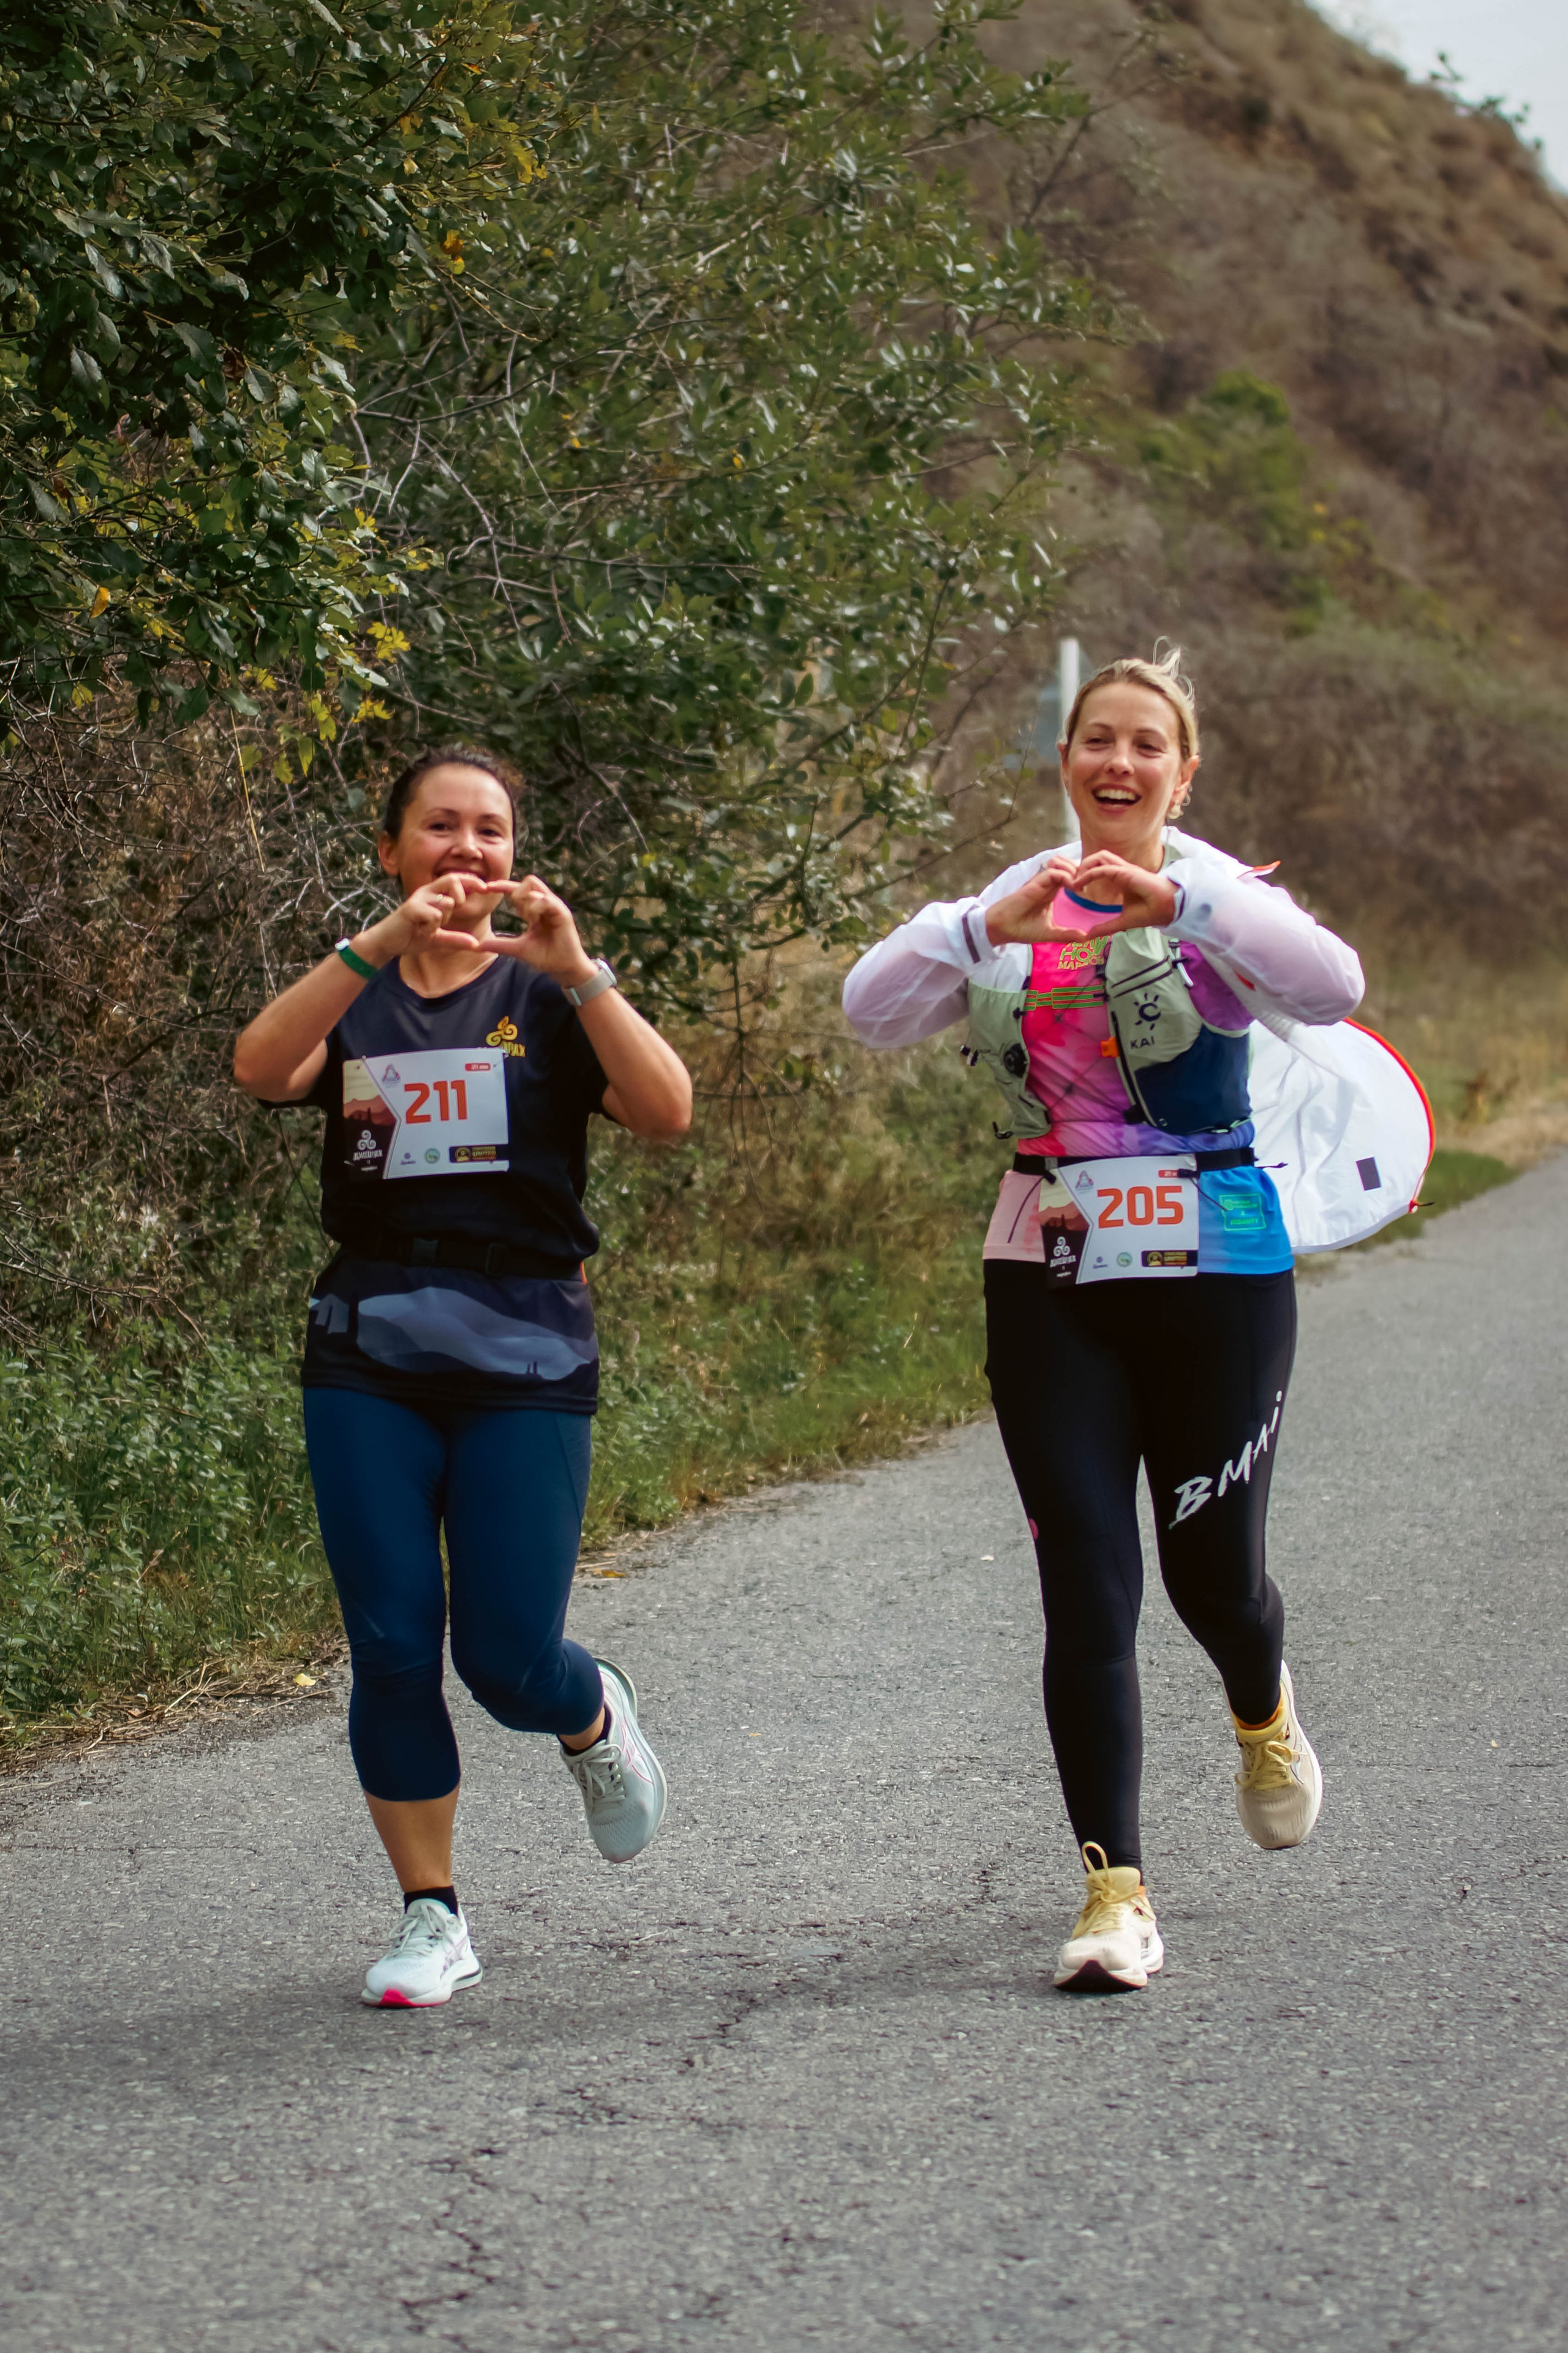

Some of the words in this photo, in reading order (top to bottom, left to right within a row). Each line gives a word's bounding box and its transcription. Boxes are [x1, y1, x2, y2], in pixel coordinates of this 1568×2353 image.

[1130, 1036, 1154, 1049] KAI
[404, 1080, 467, 1124] 211
[1097, 1185, 1183, 1228] 205
